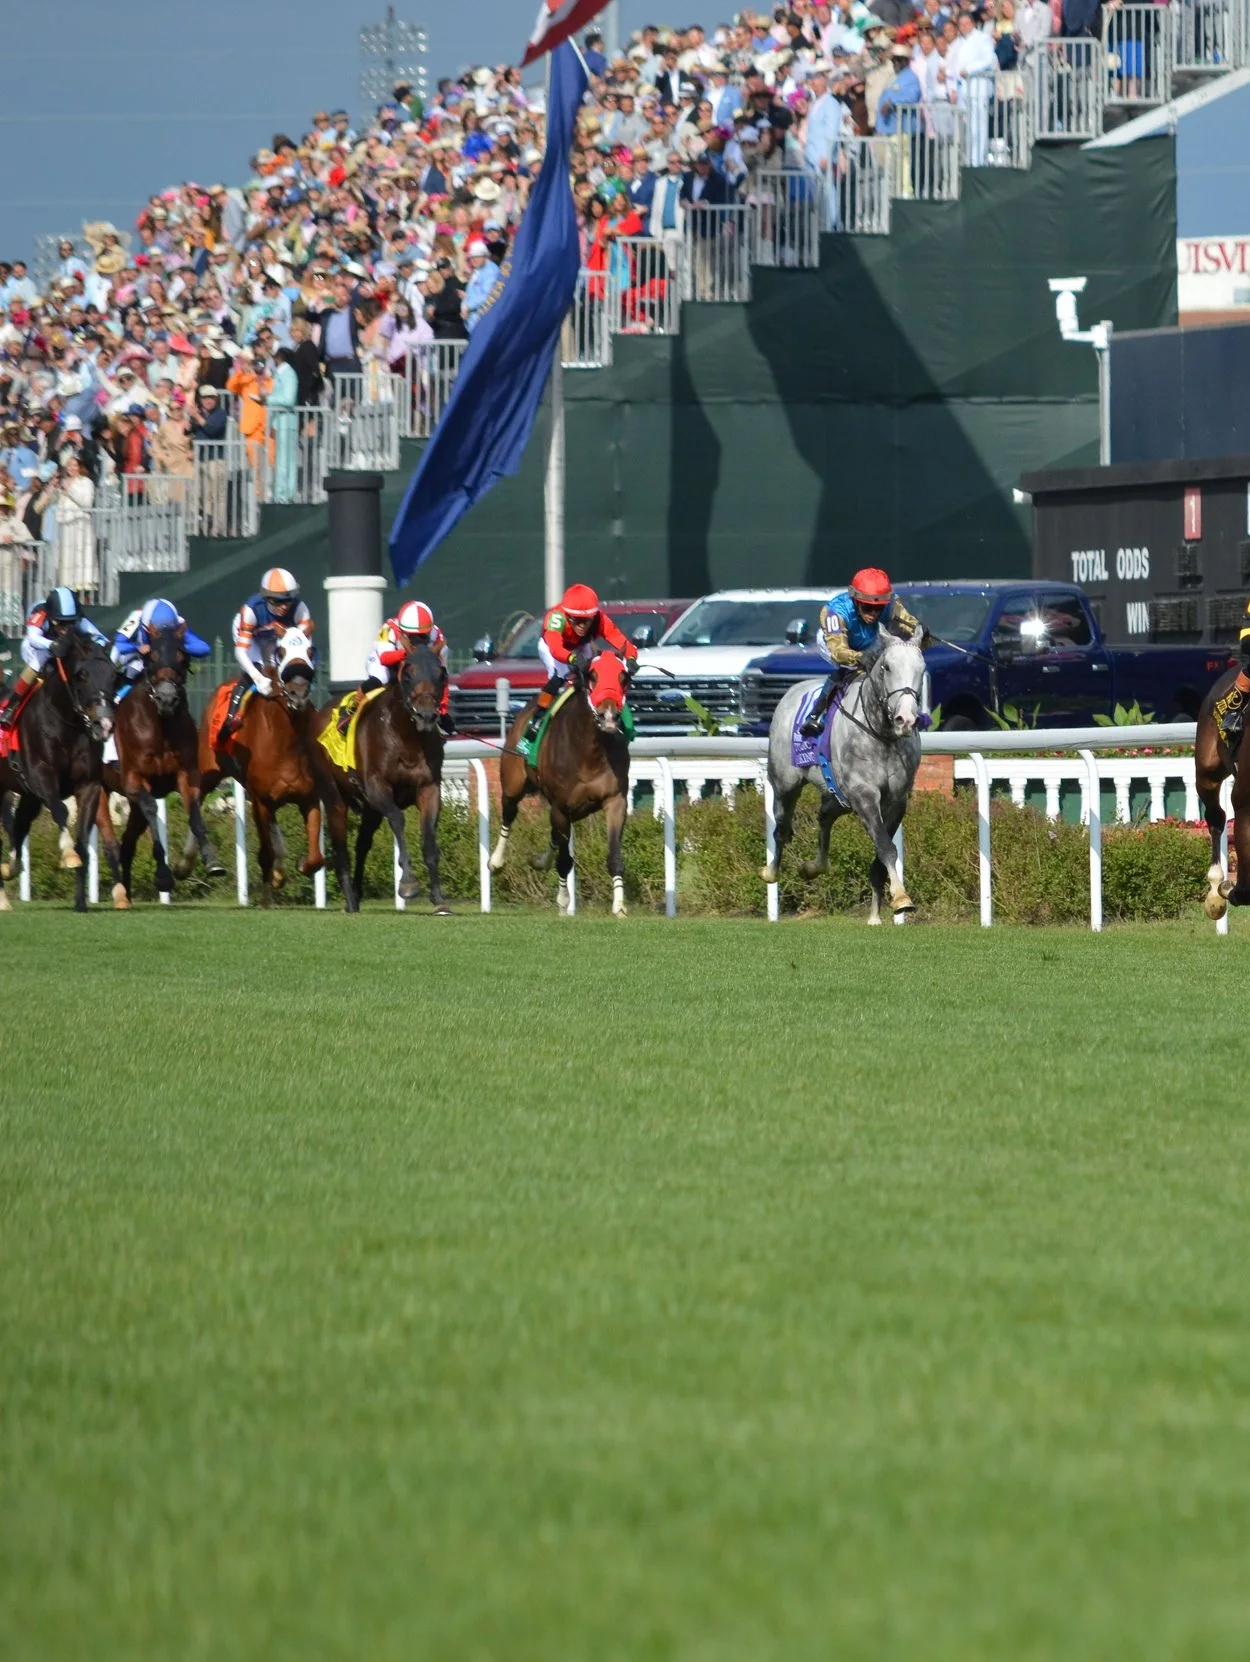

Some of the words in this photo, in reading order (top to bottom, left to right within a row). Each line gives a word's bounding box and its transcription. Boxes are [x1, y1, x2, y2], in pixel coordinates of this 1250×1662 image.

[1189, 494, 1196, 533] 1
[1071, 549, 1108, 582] TOTAL
[1116, 547, 1149, 580] ODDS
[550, 613, 563, 629] 5
[826, 614, 840, 633] 10
[1127, 602, 1150, 634] WIN
